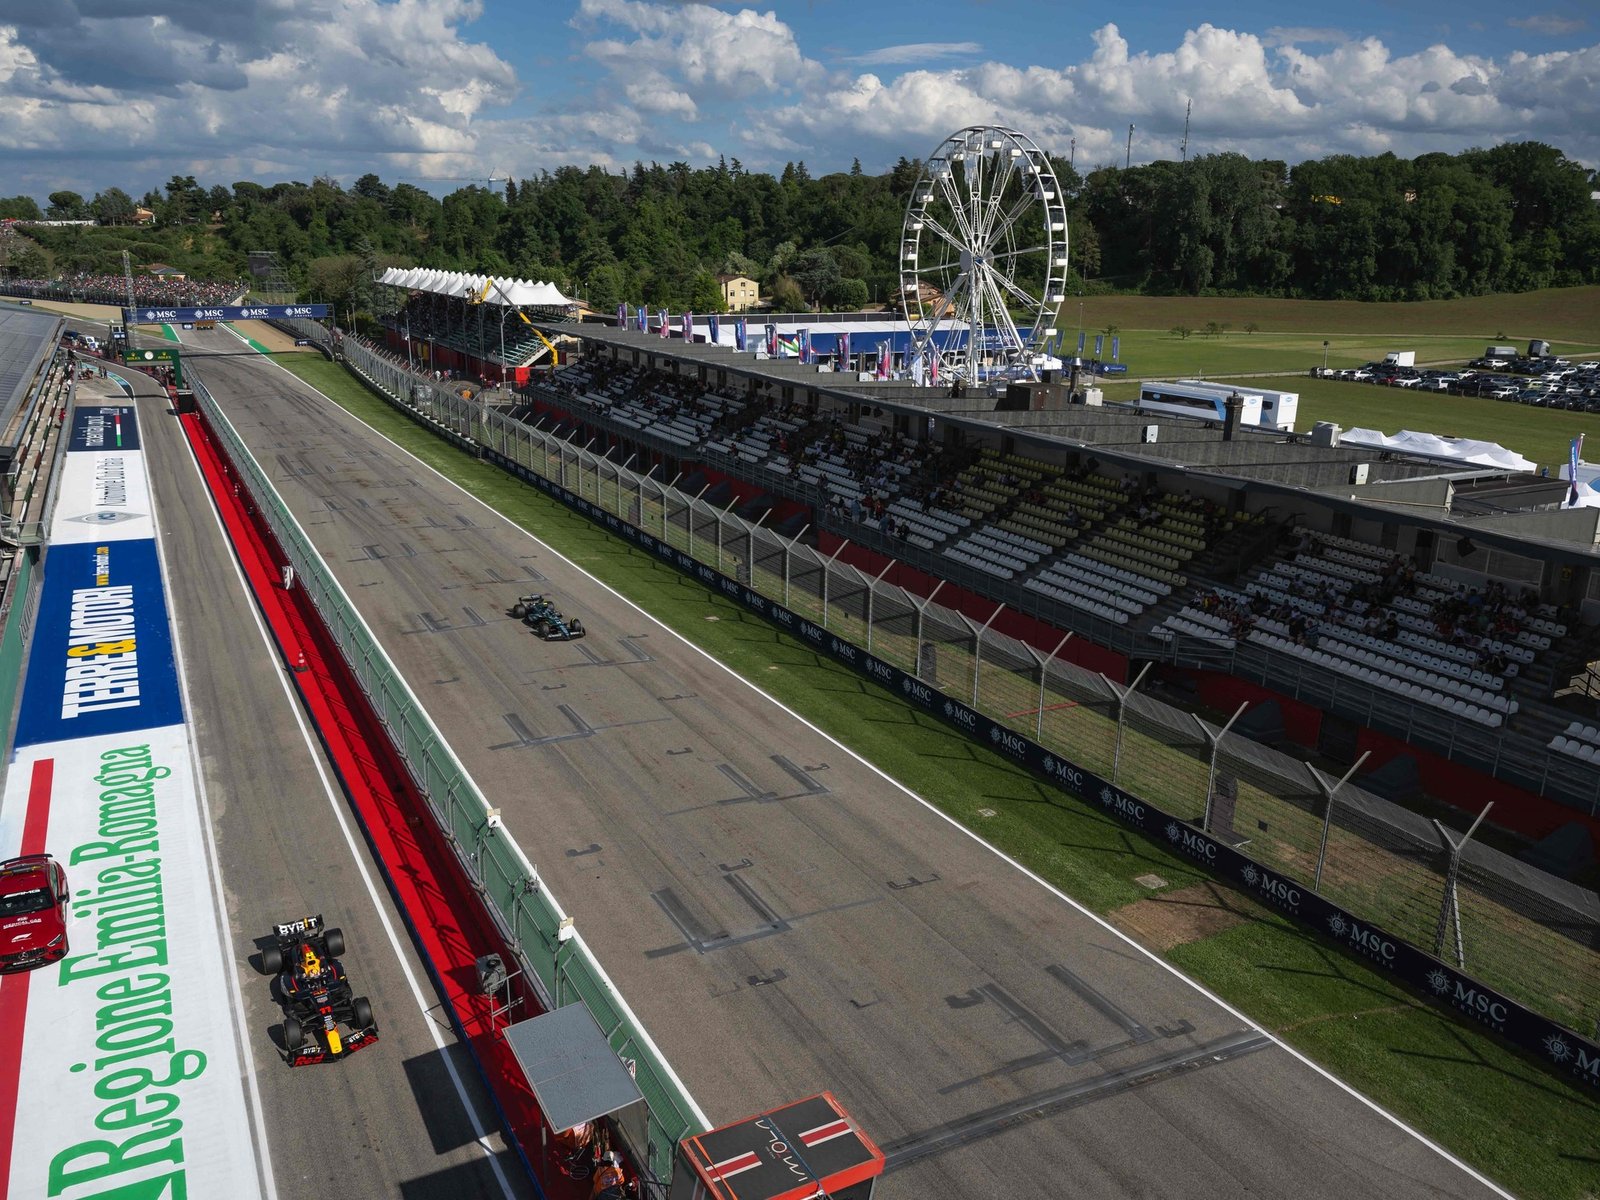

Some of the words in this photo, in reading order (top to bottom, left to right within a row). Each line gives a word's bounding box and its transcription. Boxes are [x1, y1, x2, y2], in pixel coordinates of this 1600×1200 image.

[156, 310, 176, 318] MSC
[204, 309, 224, 317] MSC
[250, 308, 269, 316] MSC
[751, 594, 764, 608] MSC
[68, 584, 136, 646] MOTORI
[778, 609, 792, 624] MSC
[807, 625, 822, 640] MSC
[67, 638, 137, 658] &
[840, 642, 855, 659] MSC
[874, 661, 892, 679] MSC
[62, 649, 140, 719] TERRE
[912, 682, 931, 702] MSC
[954, 706, 976, 726] MSC
[1002, 732, 1025, 754] MSC
[1056, 762, 1082, 785] MSC
[1115, 794, 1144, 820] MSC
[1182, 830, 1216, 859] MSC
[58, 744, 172, 987] Emilia-Romagna
[1261, 873, 1300, 906] MSC
[278, 916, 318, 935] BYBIT
[1350, 923, 1396, 960] MSC
[1454, 980, 1507, 1022] MSC
[1452, 1000, 1504, 1032] CRUISES
[294, 1054, 325, 1067] Red
[48, 969, 207, 1198] Regione
[755, 1120, 808, 1181] IMOLA
